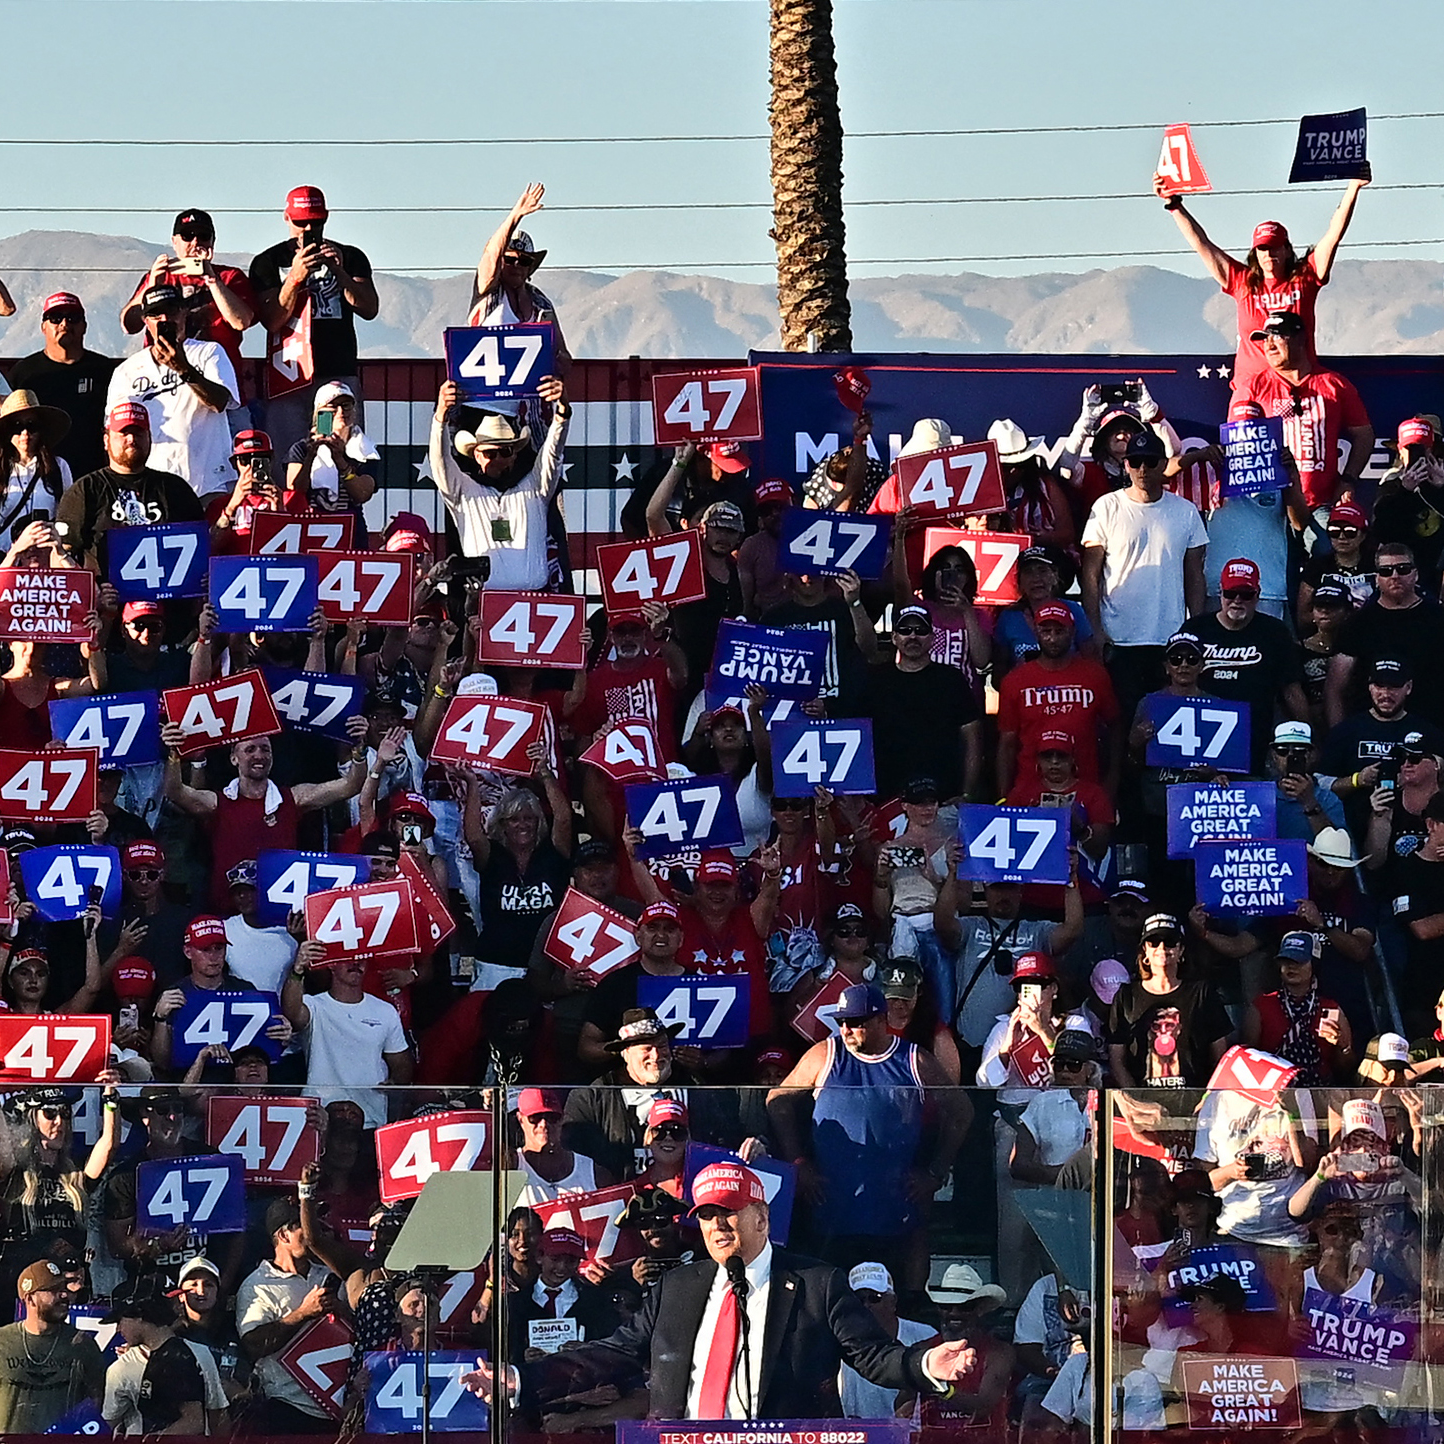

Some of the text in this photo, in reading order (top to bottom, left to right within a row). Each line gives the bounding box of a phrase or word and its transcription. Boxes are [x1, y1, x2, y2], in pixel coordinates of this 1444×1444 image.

[1306, 128, 1365, 147] TRUMP
[1159, 135, 1190, 183] 47
[1311, 145, 1361, 160] VANCE
[459, 336, 542, 386] 47
[664, 379, 746, 432] 47
[1228, 425, 1268, 441] MAKE
[1229, 454, 1272, 471] GREAT
[909, 452, 987, 509] 47
[1229, 468, 1275, 485] AGAIN!
[121, 534, 197, 588] 47
[612, 541, 690, 598] 47
[16, 574, 66, 588] MAKE
[318, 560, 401, 612] 47
[0, 589, 81, 603] AMERICA
[219, 568, 305, 618] 47
[11, 604, 70, 618] GREAT
[8, 619, 71, 632] AGAIN!
[489, 602, 574, 654] 47
[733, 646, 805, 668] VANCE
[1203, 643, 1259, 664] Trump
[720, 660, 811, 684] TRUMP
[1214, 670, 1238, 679] 2024
[1025, 688, 1093, 708] Trump
[178, 681, 254, 739] 47
[446, 704, 533, 759] 47
[1157, 707, 1238, 758] 47
[604, 726, 657, 768] 47
[783, 730, 860, 782] 47
[1, 759, 86, 810] 47
[1195, 790, 1245, 804] MAKE
[640, 786, 721, 841] 47
[1180, 804, 1261, 819] AMERICA
[1191, 819, 1250, 833] GREAT
[969, 818, 1056, 870] 47
[1225, 848, 1276, 862] MAKE
[1210, 863, 1292, 877] AMERICA
[1221, 878, 1282, 892] GREAT
[501, 893, 553, 910] MAGA
[1221, 893, 1284, 906] AGAIN!
[315, 891, 400, 950] 47
[558, 912, 640, 974] 47
[184, 1002, 269, 1052] 47
[4, 1026, 96, 1078] 47
[148, 1167, 229, 1223] 47
[532, 1323, 571, 1333] DONALD
[1309, 1308, 1406, 1348] TRUMP
[1316, 1330, 1390, 1364] VANCE
[1213, 1365, 1264, 1378] MAKE
[1199, 1380, 1286, 1393] AMERICA
[1212, 1394, 1273, 1407] GREAT
[1211, 1409, 1277, 1422] AGAIN!
[662, 1432, 865, 1444] TEXT CALIFORNIA TO 88022
